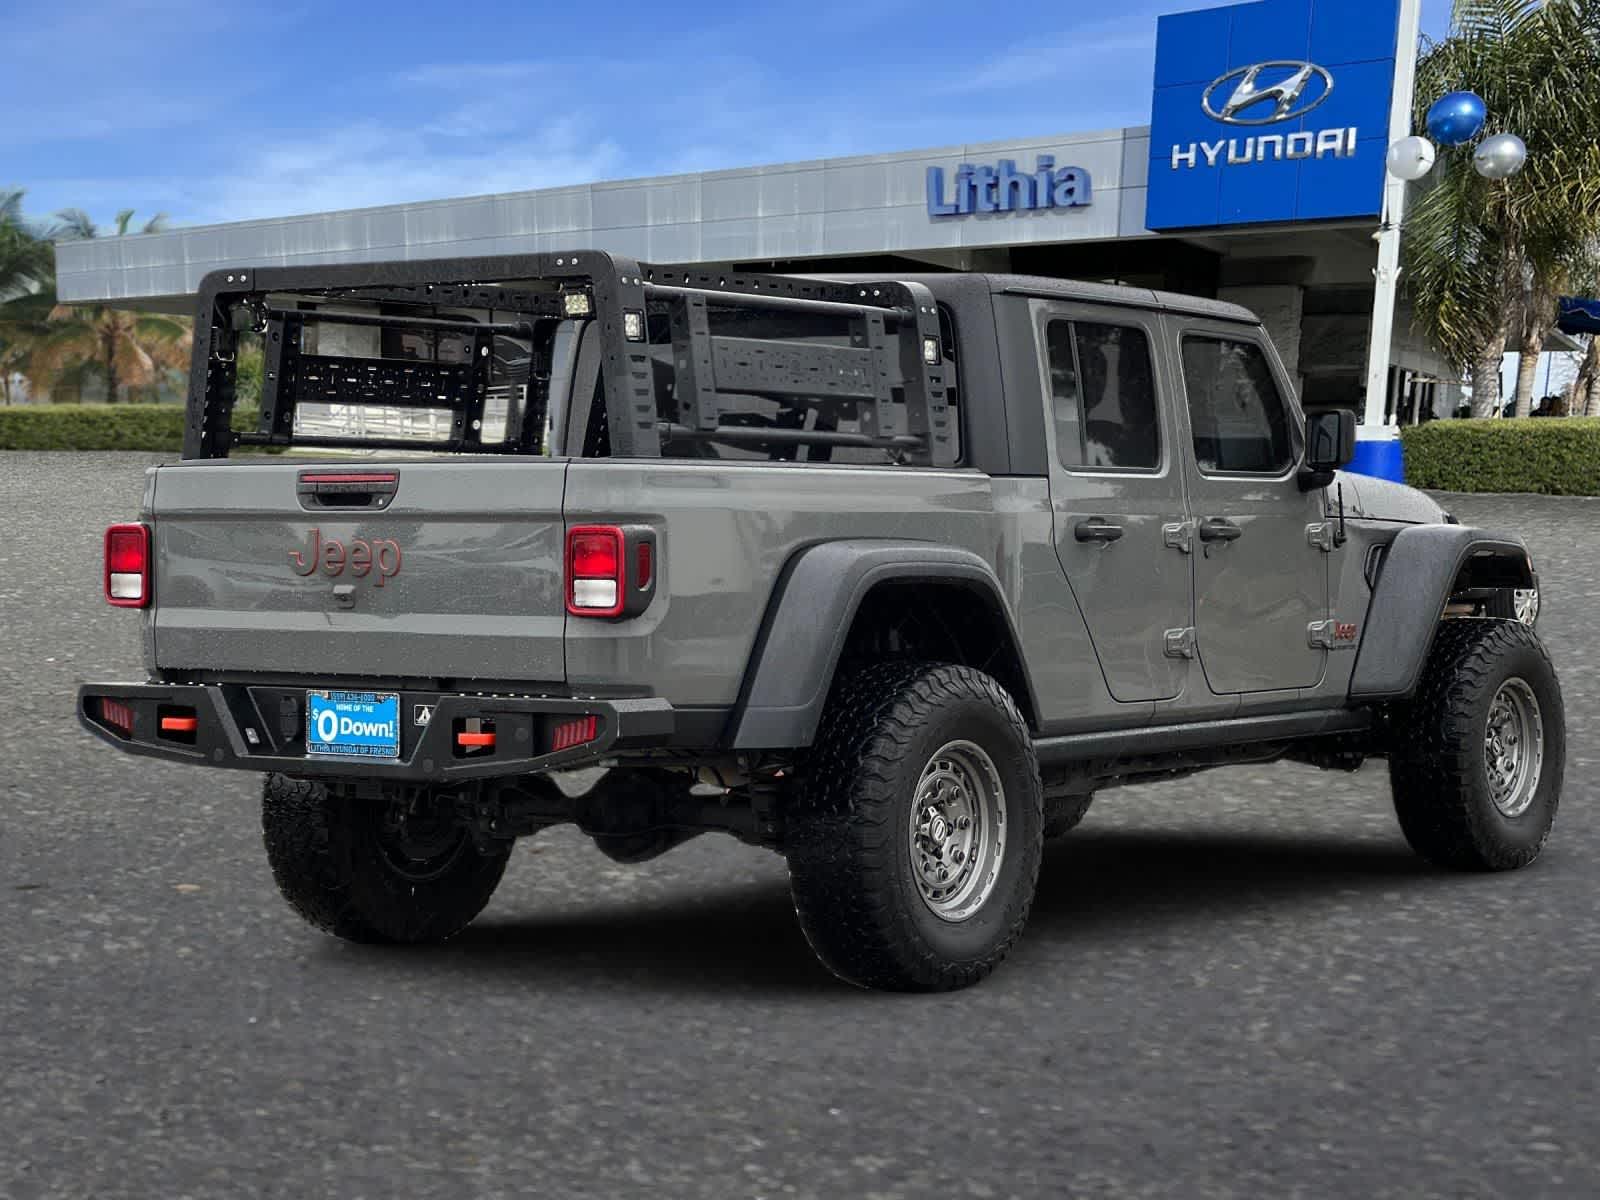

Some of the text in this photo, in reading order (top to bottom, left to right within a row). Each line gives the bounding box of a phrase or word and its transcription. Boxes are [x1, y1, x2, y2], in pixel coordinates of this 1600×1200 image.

[1171, 127, 1357, 169] HYUNDAI
[926, 154, 1092, 217] Lithia
[288, 527, 402, 588] Jeep
[336, 704, 375, 713] HOME OF THE
[340, 717, 394, 738] Down!
[331, 744, 359, 753] HYUNDAI
[369, 746, 395, 756] FRESNO
